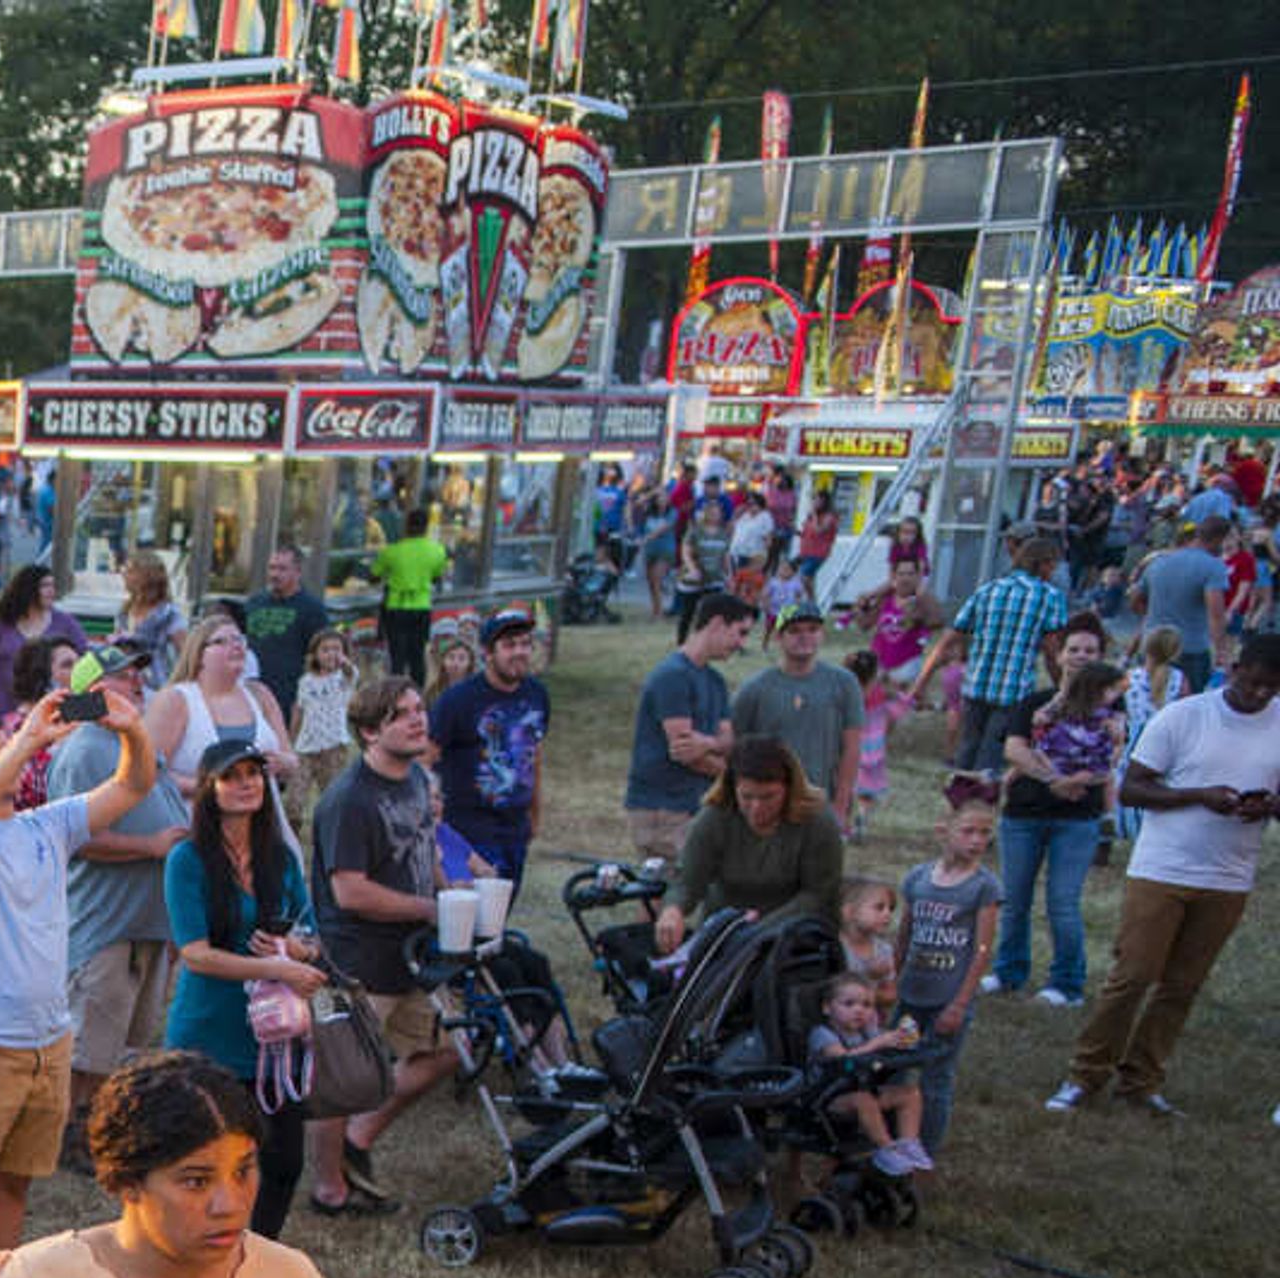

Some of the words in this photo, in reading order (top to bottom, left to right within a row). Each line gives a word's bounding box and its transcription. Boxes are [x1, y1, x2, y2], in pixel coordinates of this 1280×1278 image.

[126, 107, 323, 171] PIZZA
[446, 130, 539, 223] PIZZA
[43, 402, 151, 438] CHEESY
[158, 401, 268, 437] STICKS
[305, 399, 419, 439] Coca-Cola
[804, 430, 907, 456] TICKETS
